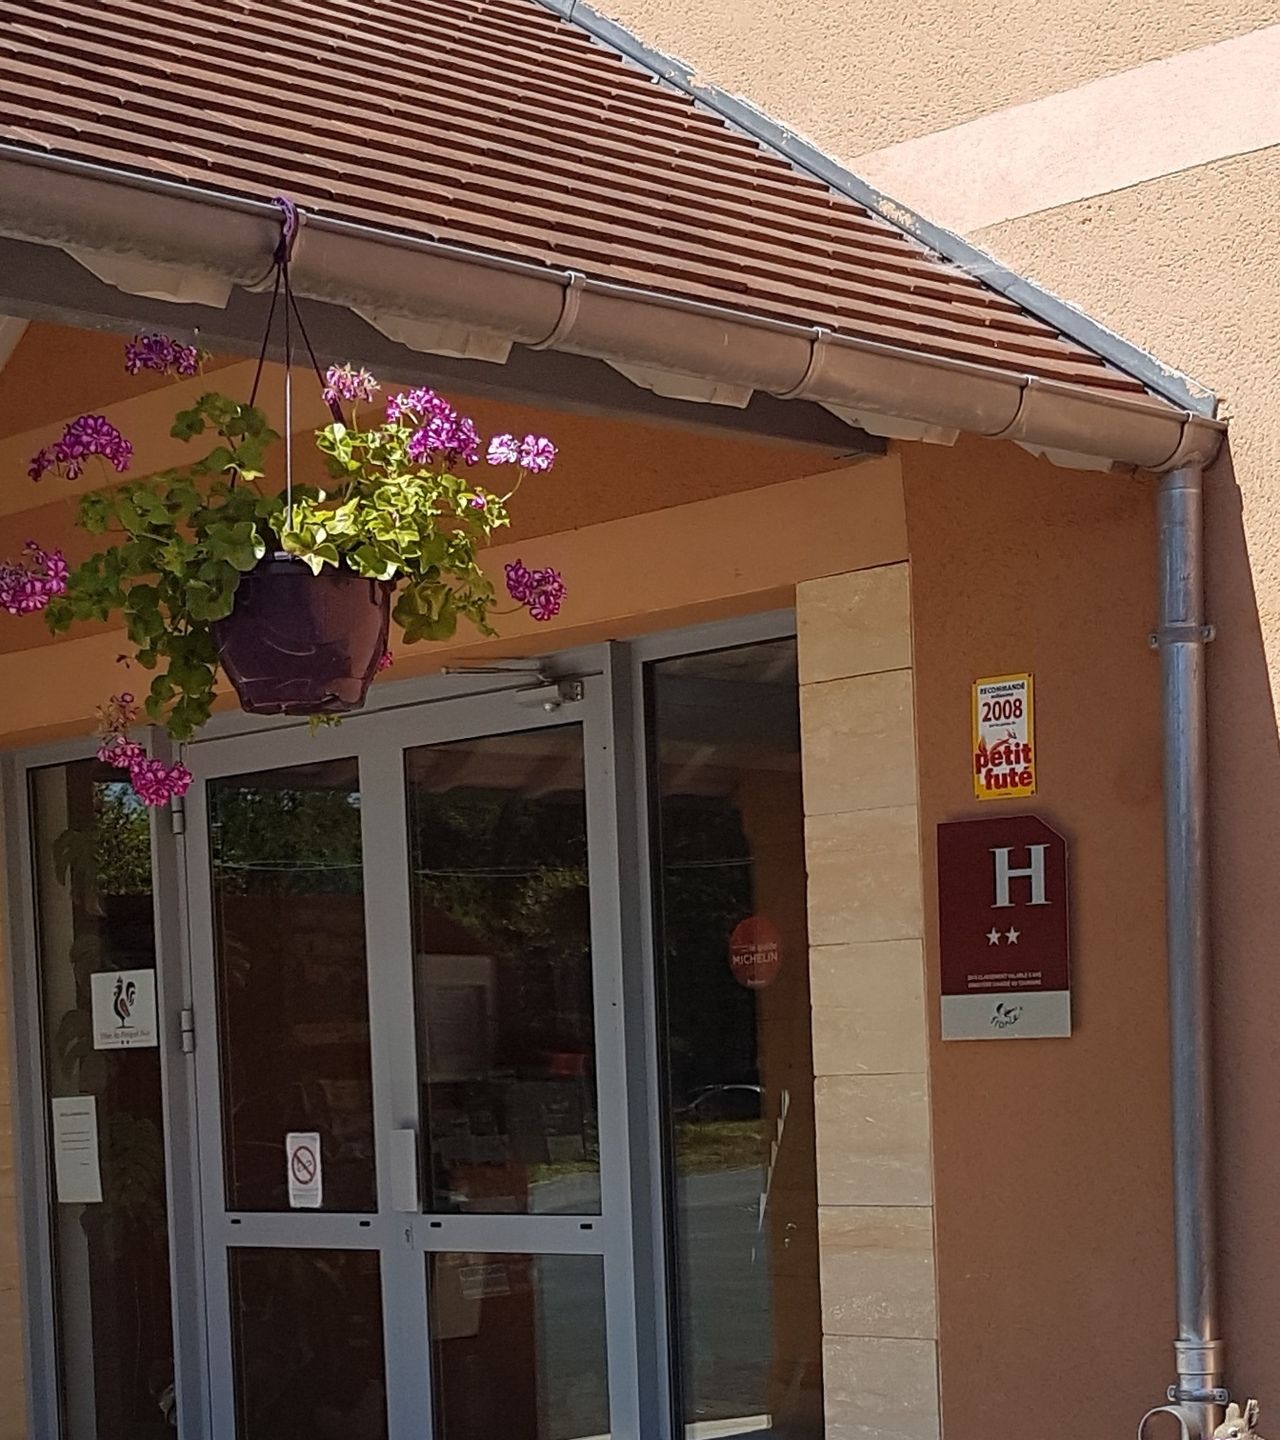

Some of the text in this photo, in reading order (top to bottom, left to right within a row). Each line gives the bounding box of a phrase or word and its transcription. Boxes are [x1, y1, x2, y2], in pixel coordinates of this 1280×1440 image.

[982, 698, 1023, 723] 2008
[975, 742, 1032, 775] petit
[985, 766, 1032, 790] futé
[988, 843, 1052, 909] H
[732, 952, 778, 965] MICHELIN
